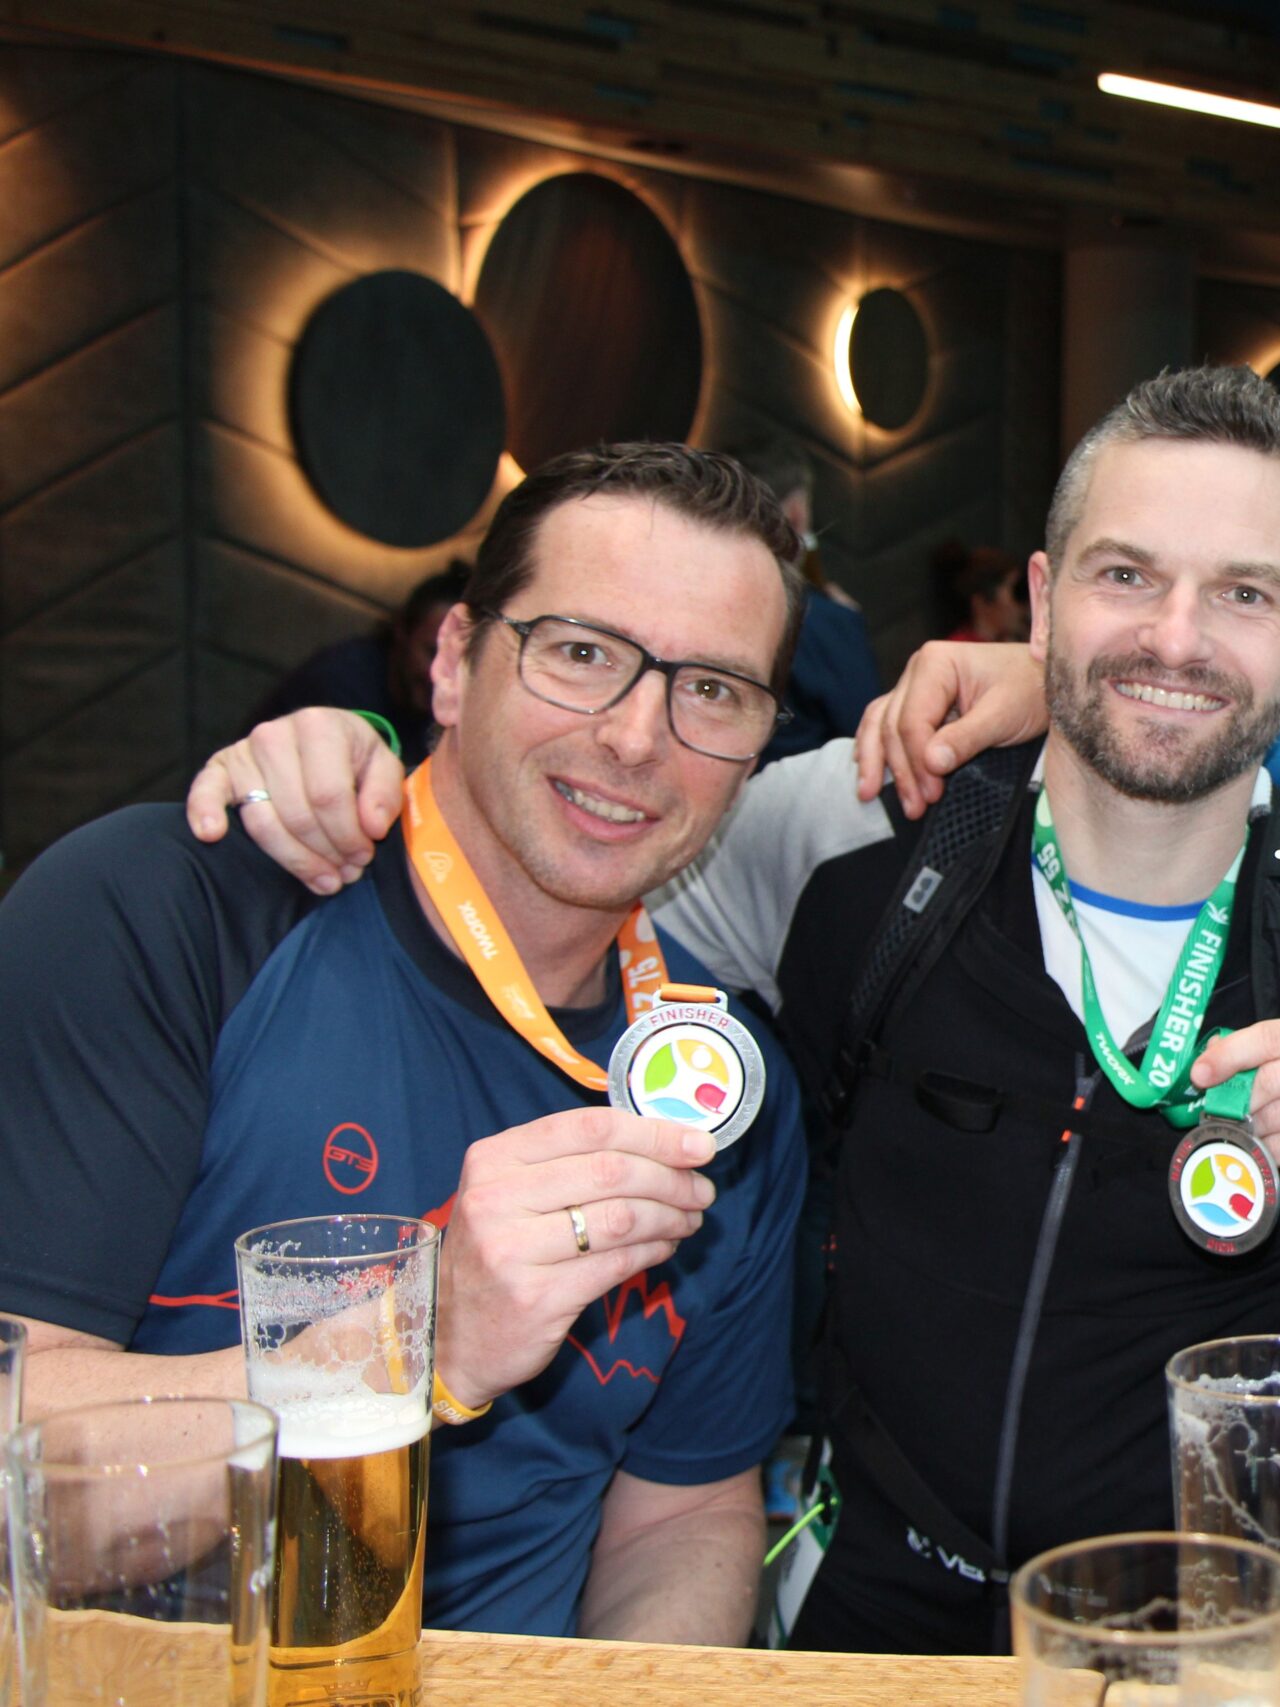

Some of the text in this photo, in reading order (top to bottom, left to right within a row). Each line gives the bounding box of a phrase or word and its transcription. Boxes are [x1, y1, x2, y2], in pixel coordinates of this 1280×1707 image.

[458, 900, 499, 960] TWORX
[649, 1007, 730, 1030] FINISHER
[1159, 929, 1222, 1053] FINISHER
[1096, 1031, 1136, 1086] TWORX
[326, 1145, 376, 1173] GTS
